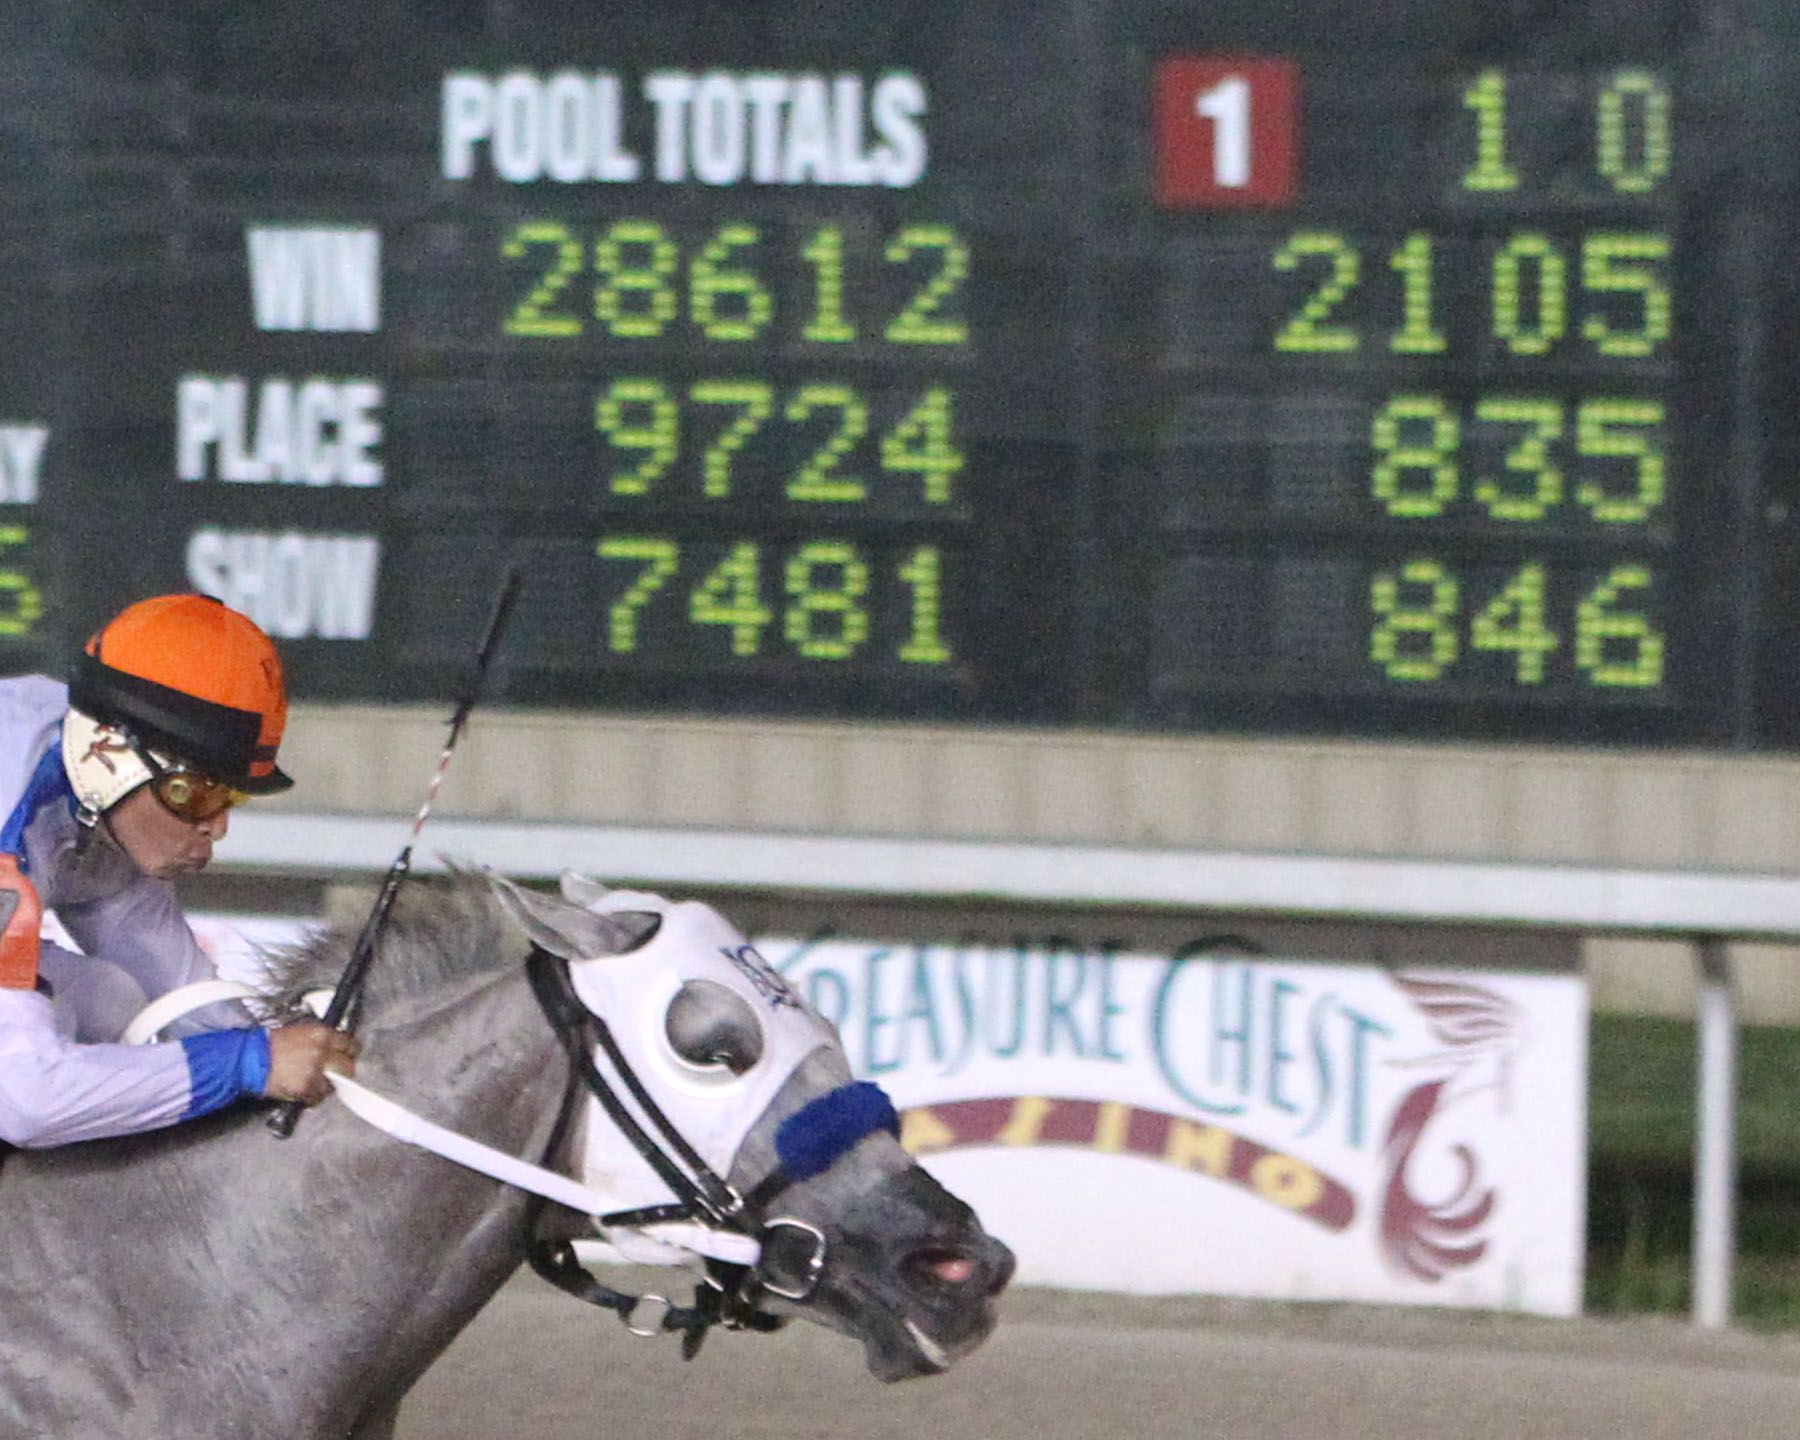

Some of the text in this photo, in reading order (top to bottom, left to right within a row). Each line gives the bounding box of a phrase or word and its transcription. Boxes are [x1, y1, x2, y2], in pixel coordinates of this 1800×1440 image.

[442, 70, 928, 188] POOL TOTALS
[1196, 76, 1251, 188] 1
[246, 226, 381, 333] WIN
[502, 222, 968, 344] 28612
[176, 377, 384, 487] PLACE
[596, 379, 964, 502] 9724
[1372, 397, 1663, 521] 835
[186, 528, 379, 640] SHOW
[599, 538, 952, 663] 7481
[1371, 561, 1663, 687] 846
[776, 926, 1396, 1152] REASURE CHEST
[901, 1098, 1325, 1212] ASINO
